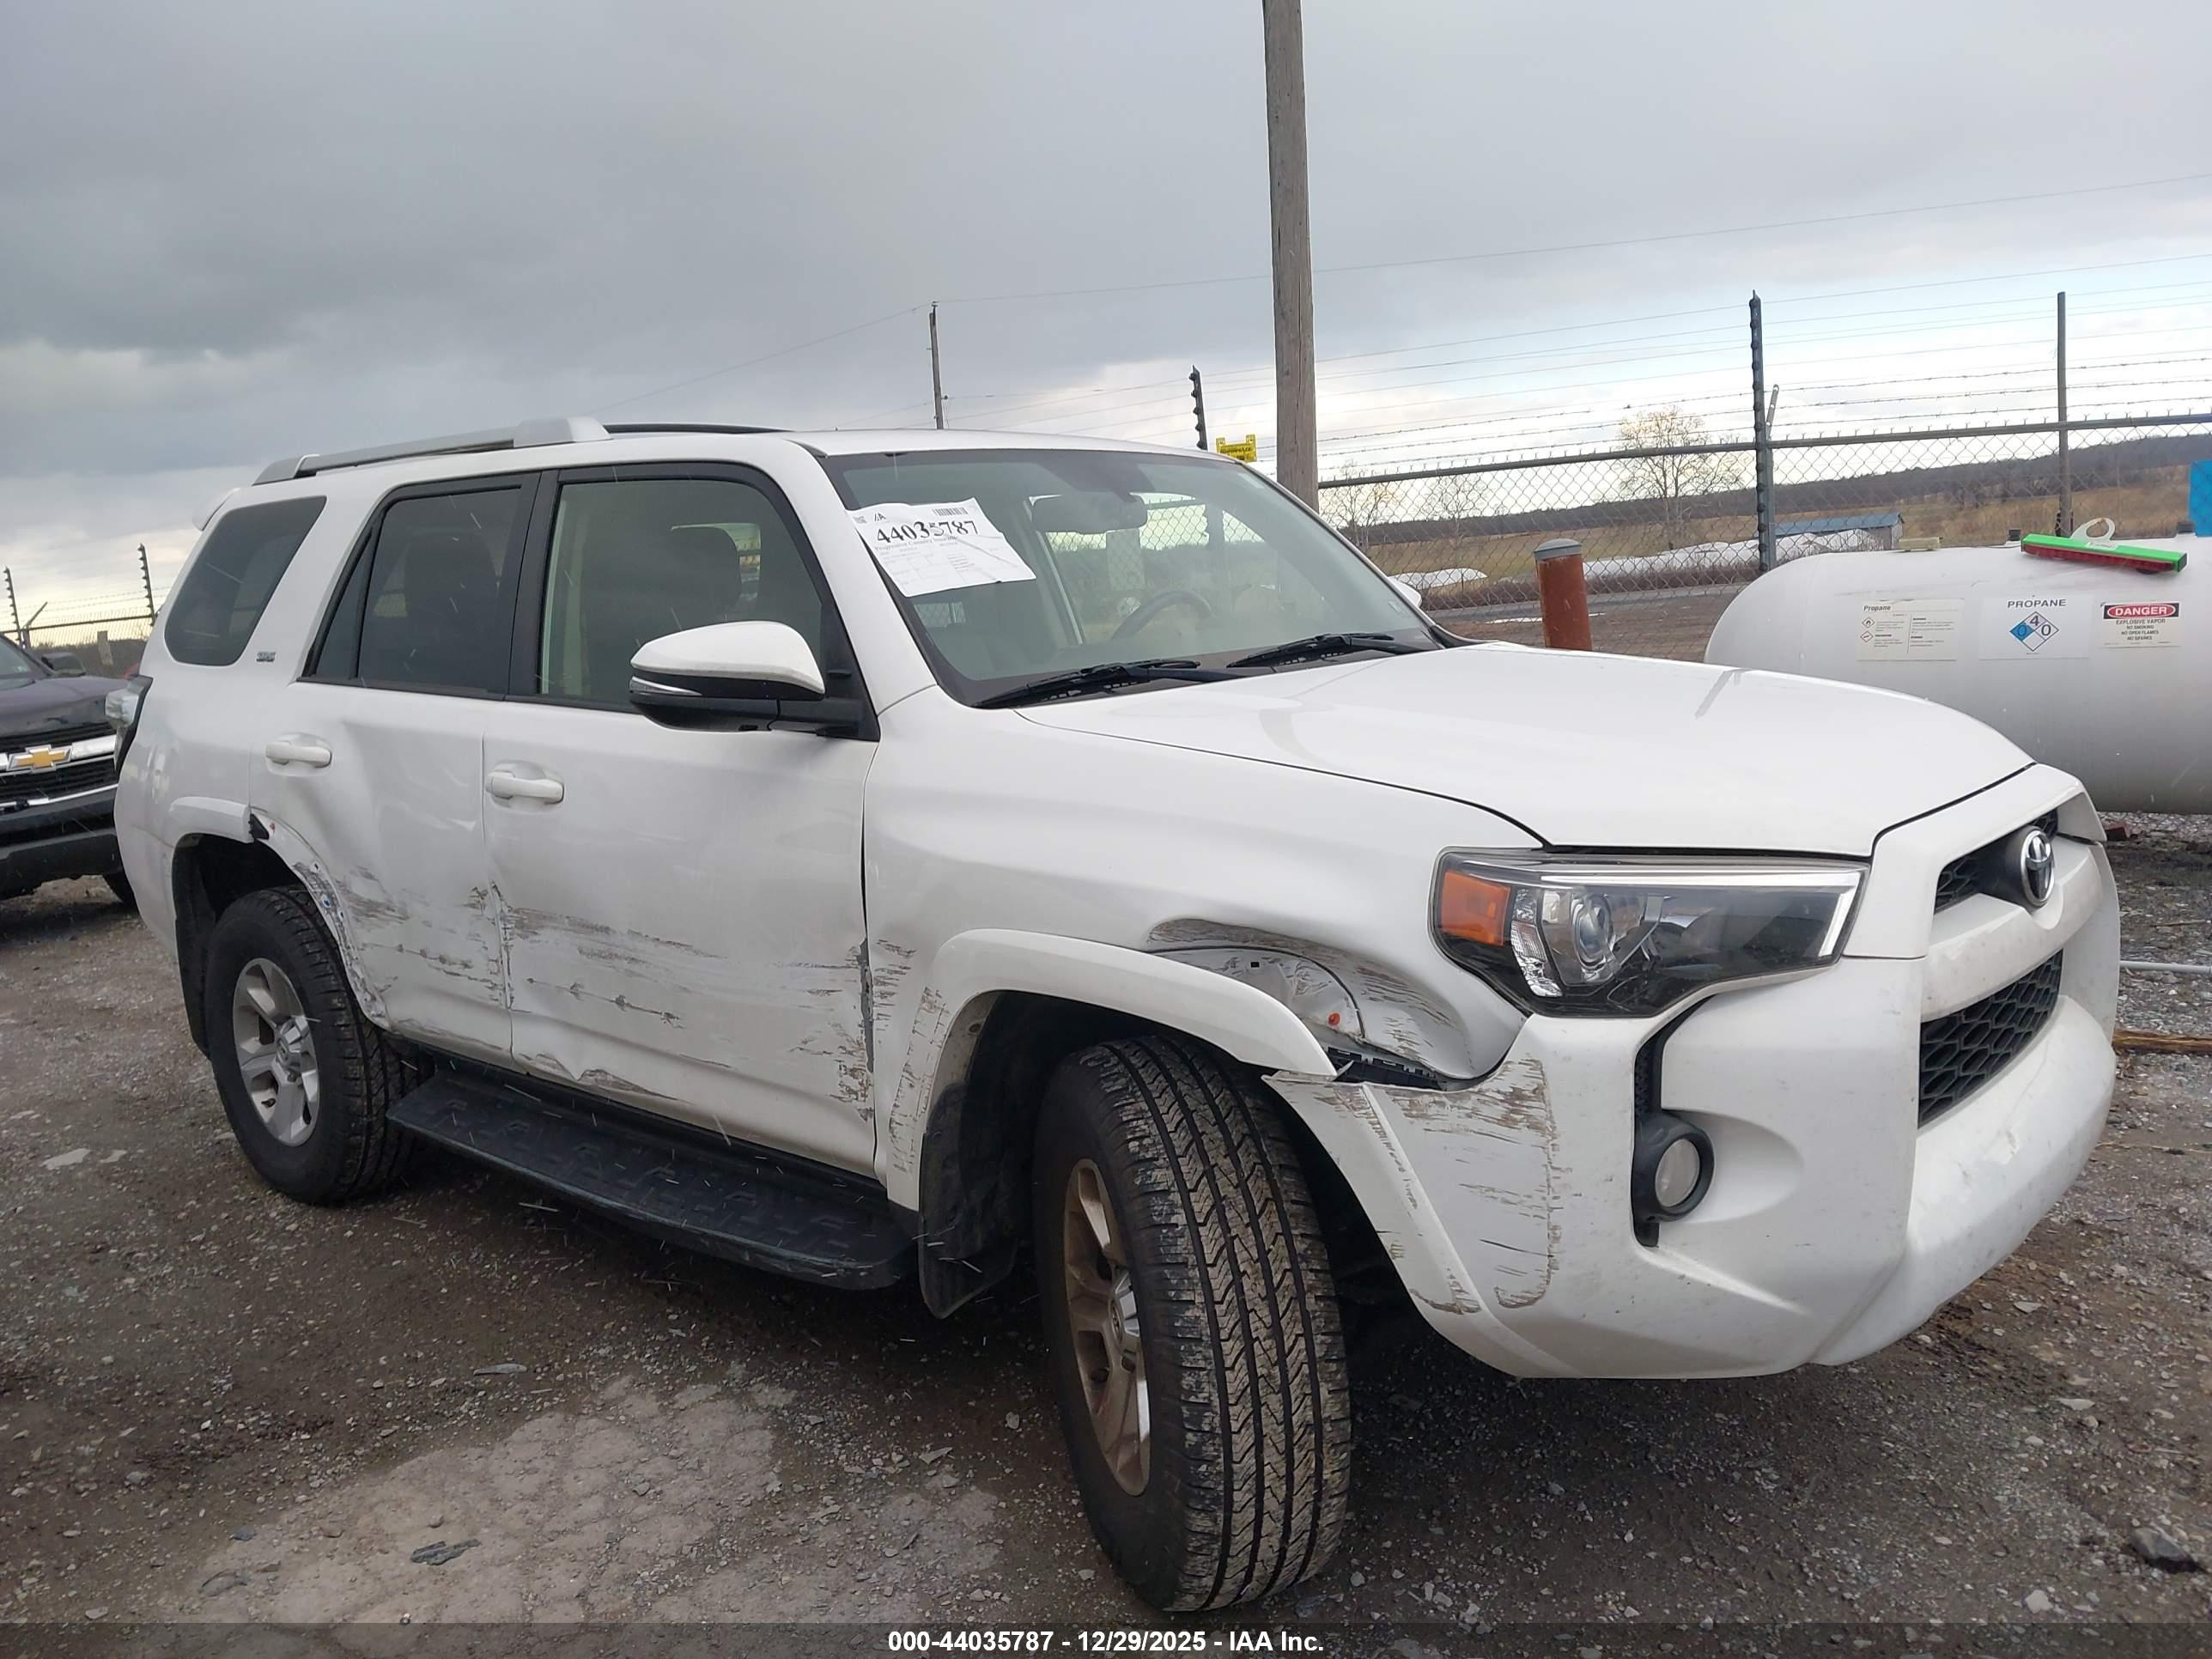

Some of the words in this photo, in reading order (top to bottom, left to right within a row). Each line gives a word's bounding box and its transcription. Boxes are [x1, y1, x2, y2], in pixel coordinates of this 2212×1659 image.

[877, 520, 978, 543] 44035787
[2007, 599, 2067, 608] PROPANE
[2115, 606, 2167, 616] DANGER
[2029, 615, 2040, 626] 4
[2017, 624, 2027, 637] 0
[2041, 623, 2051, 636] 0
